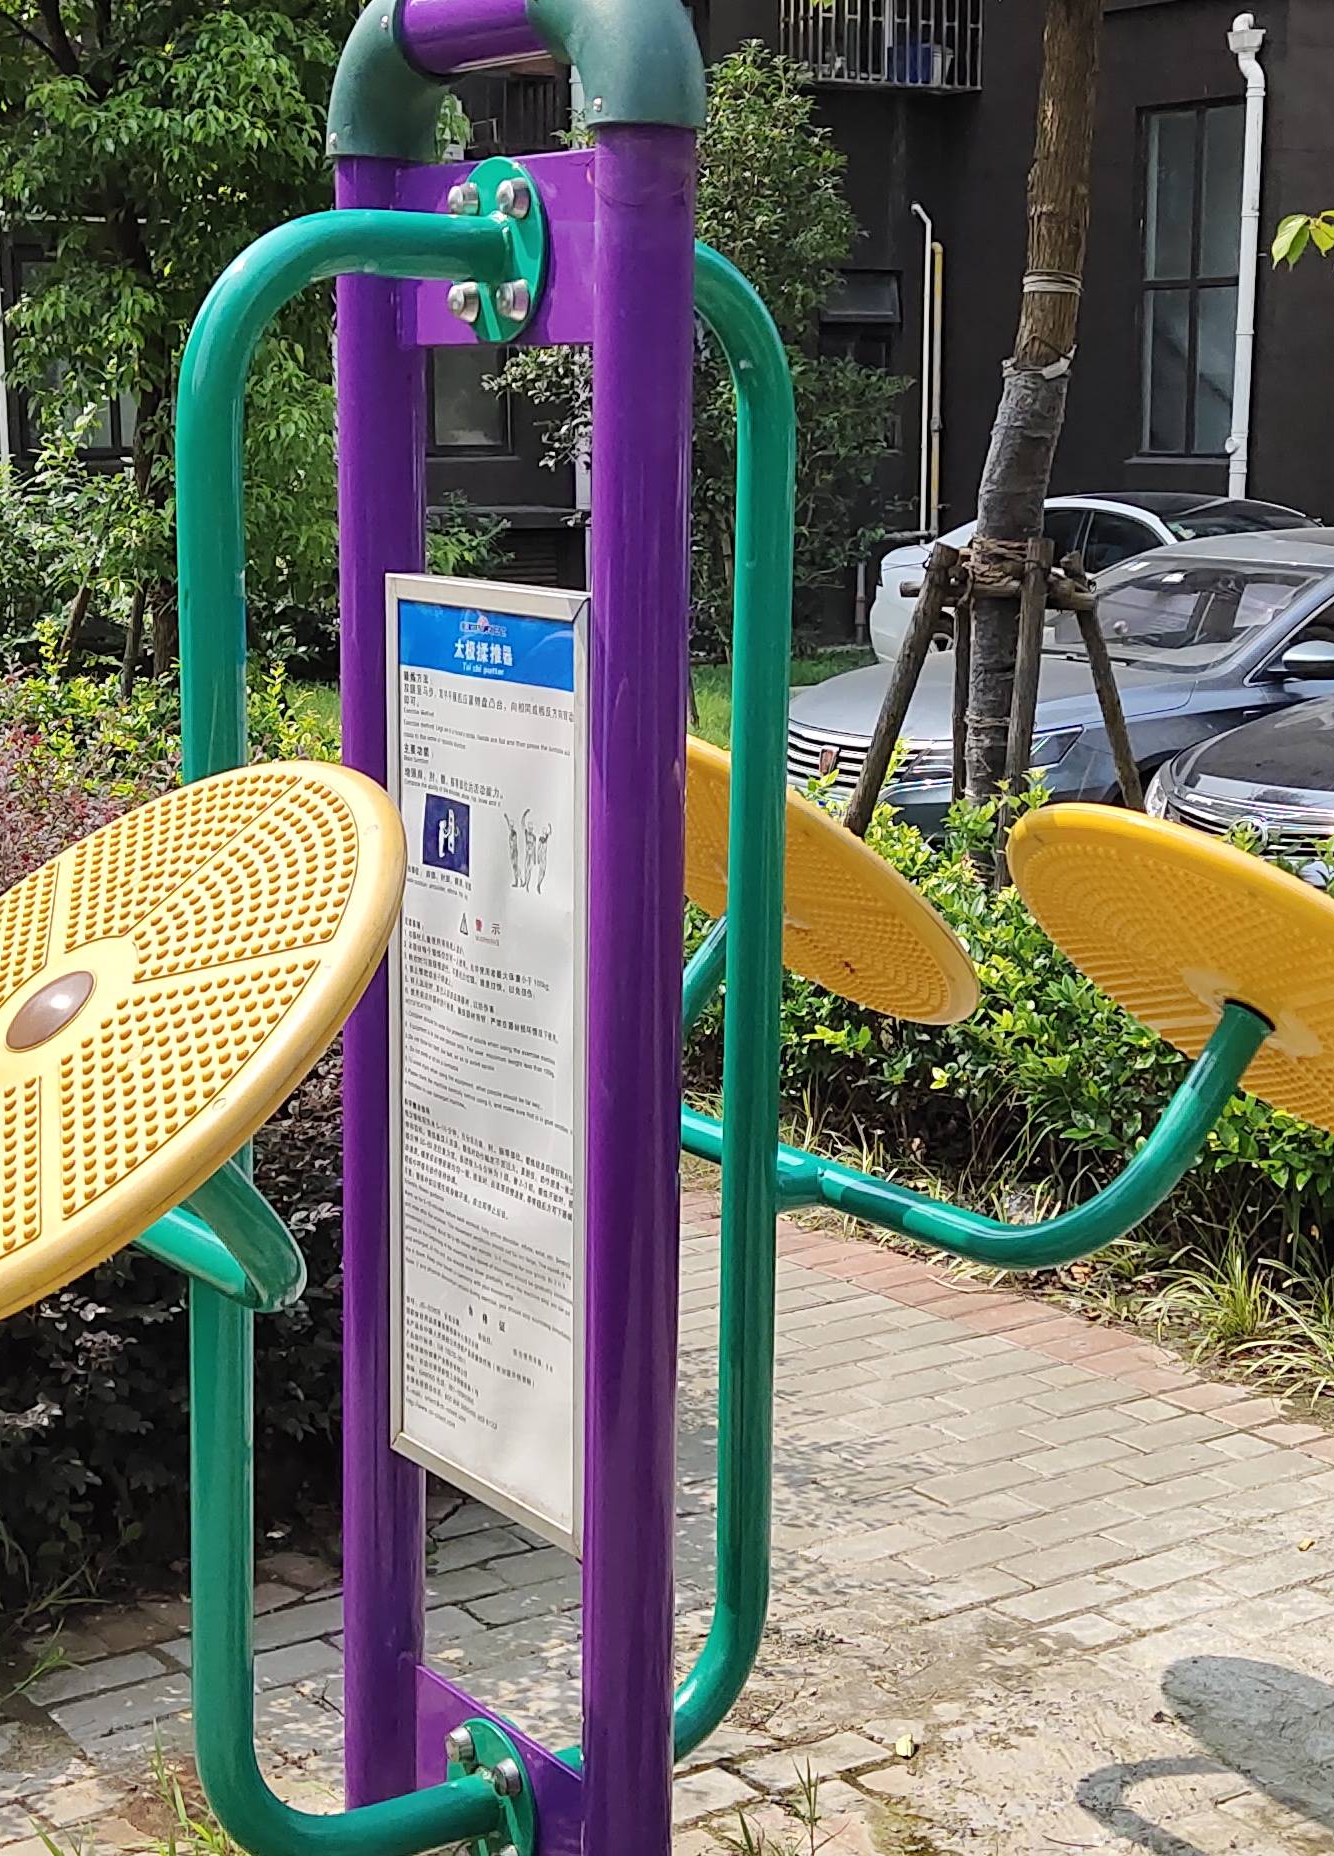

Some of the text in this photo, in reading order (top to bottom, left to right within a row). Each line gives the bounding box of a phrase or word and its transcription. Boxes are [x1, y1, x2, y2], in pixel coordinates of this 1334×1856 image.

[454, 638, 513, 667] 太极揉推器
